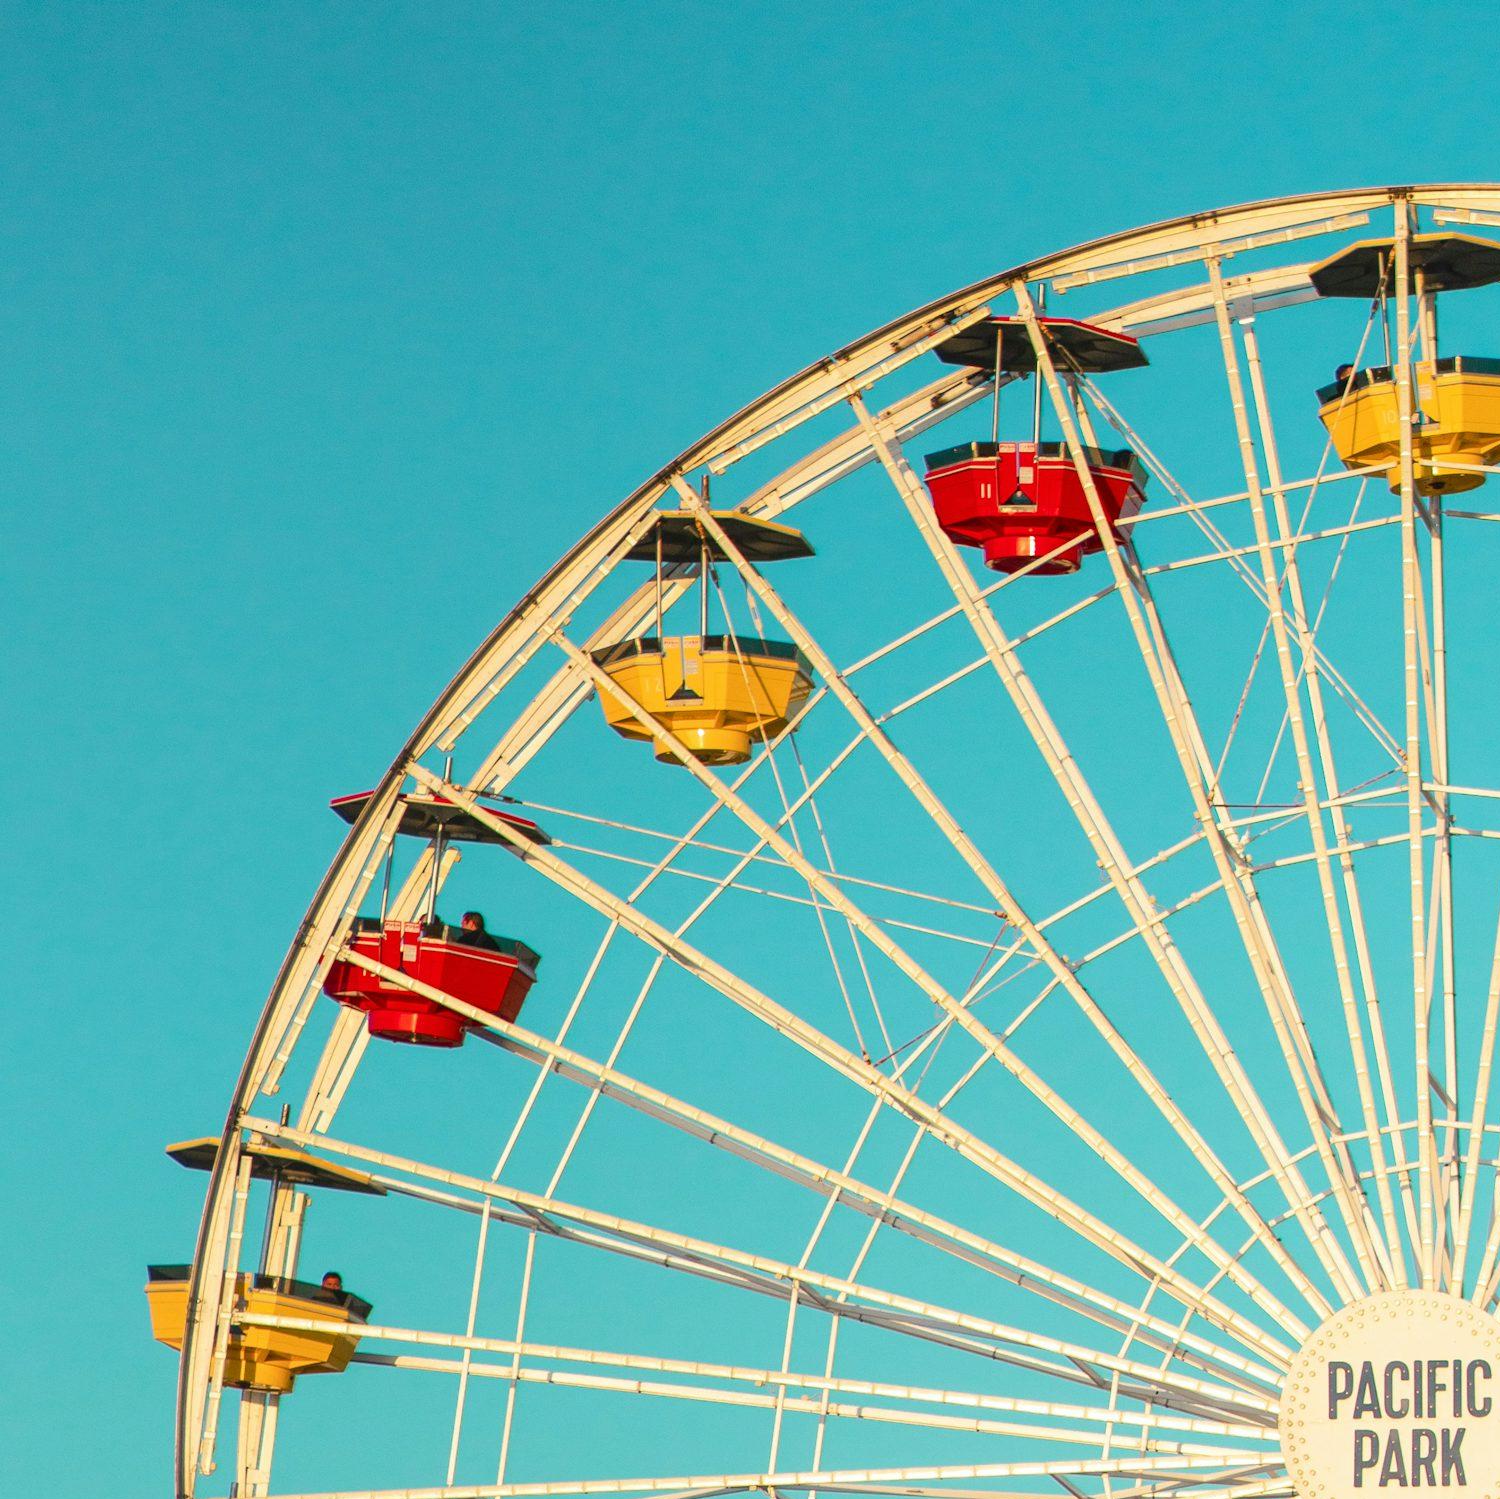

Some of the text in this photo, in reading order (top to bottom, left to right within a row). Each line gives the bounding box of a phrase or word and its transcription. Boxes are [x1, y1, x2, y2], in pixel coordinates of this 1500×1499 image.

[980, 483, 992, 499] 11
[1328, 1359, 1493, 1419] PACIFIC
[1354, 1428, 1467, 1488] PARK
